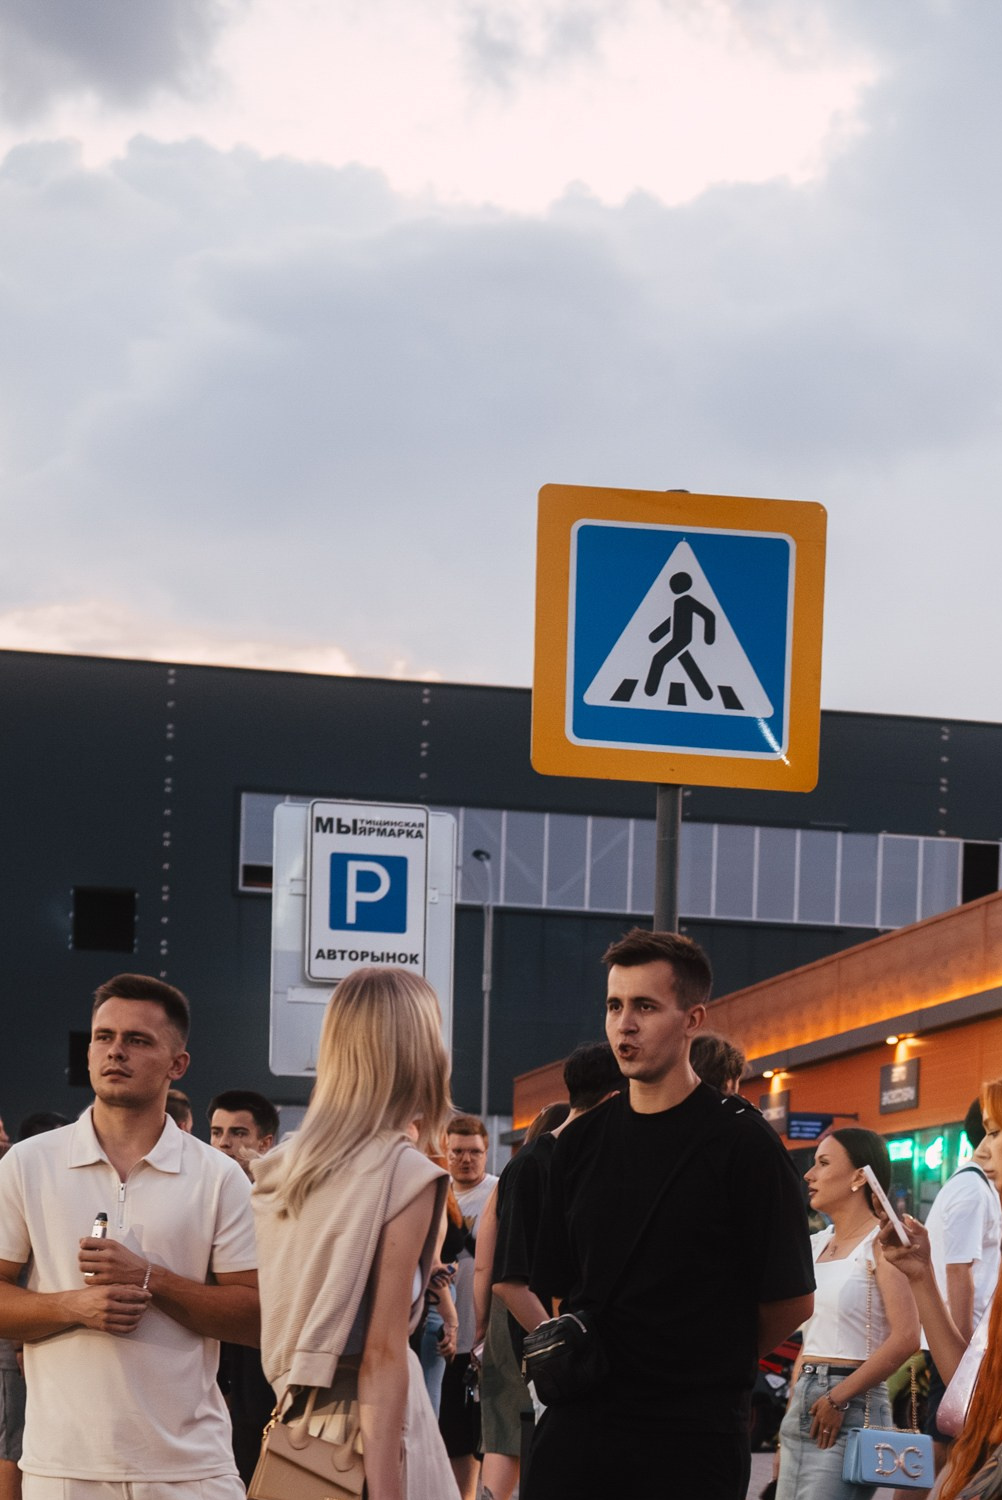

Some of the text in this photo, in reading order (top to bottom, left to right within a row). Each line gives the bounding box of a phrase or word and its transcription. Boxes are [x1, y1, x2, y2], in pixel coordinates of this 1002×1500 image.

[315, 816, 358, 836] МЫ
[358, 827, 424, 839] ЯРМАРКА
[346, 860, 391, 924] P
[315, 948, 420, 965] АВТОРЫНОК
[874, 1442, 924, 1480] DG
